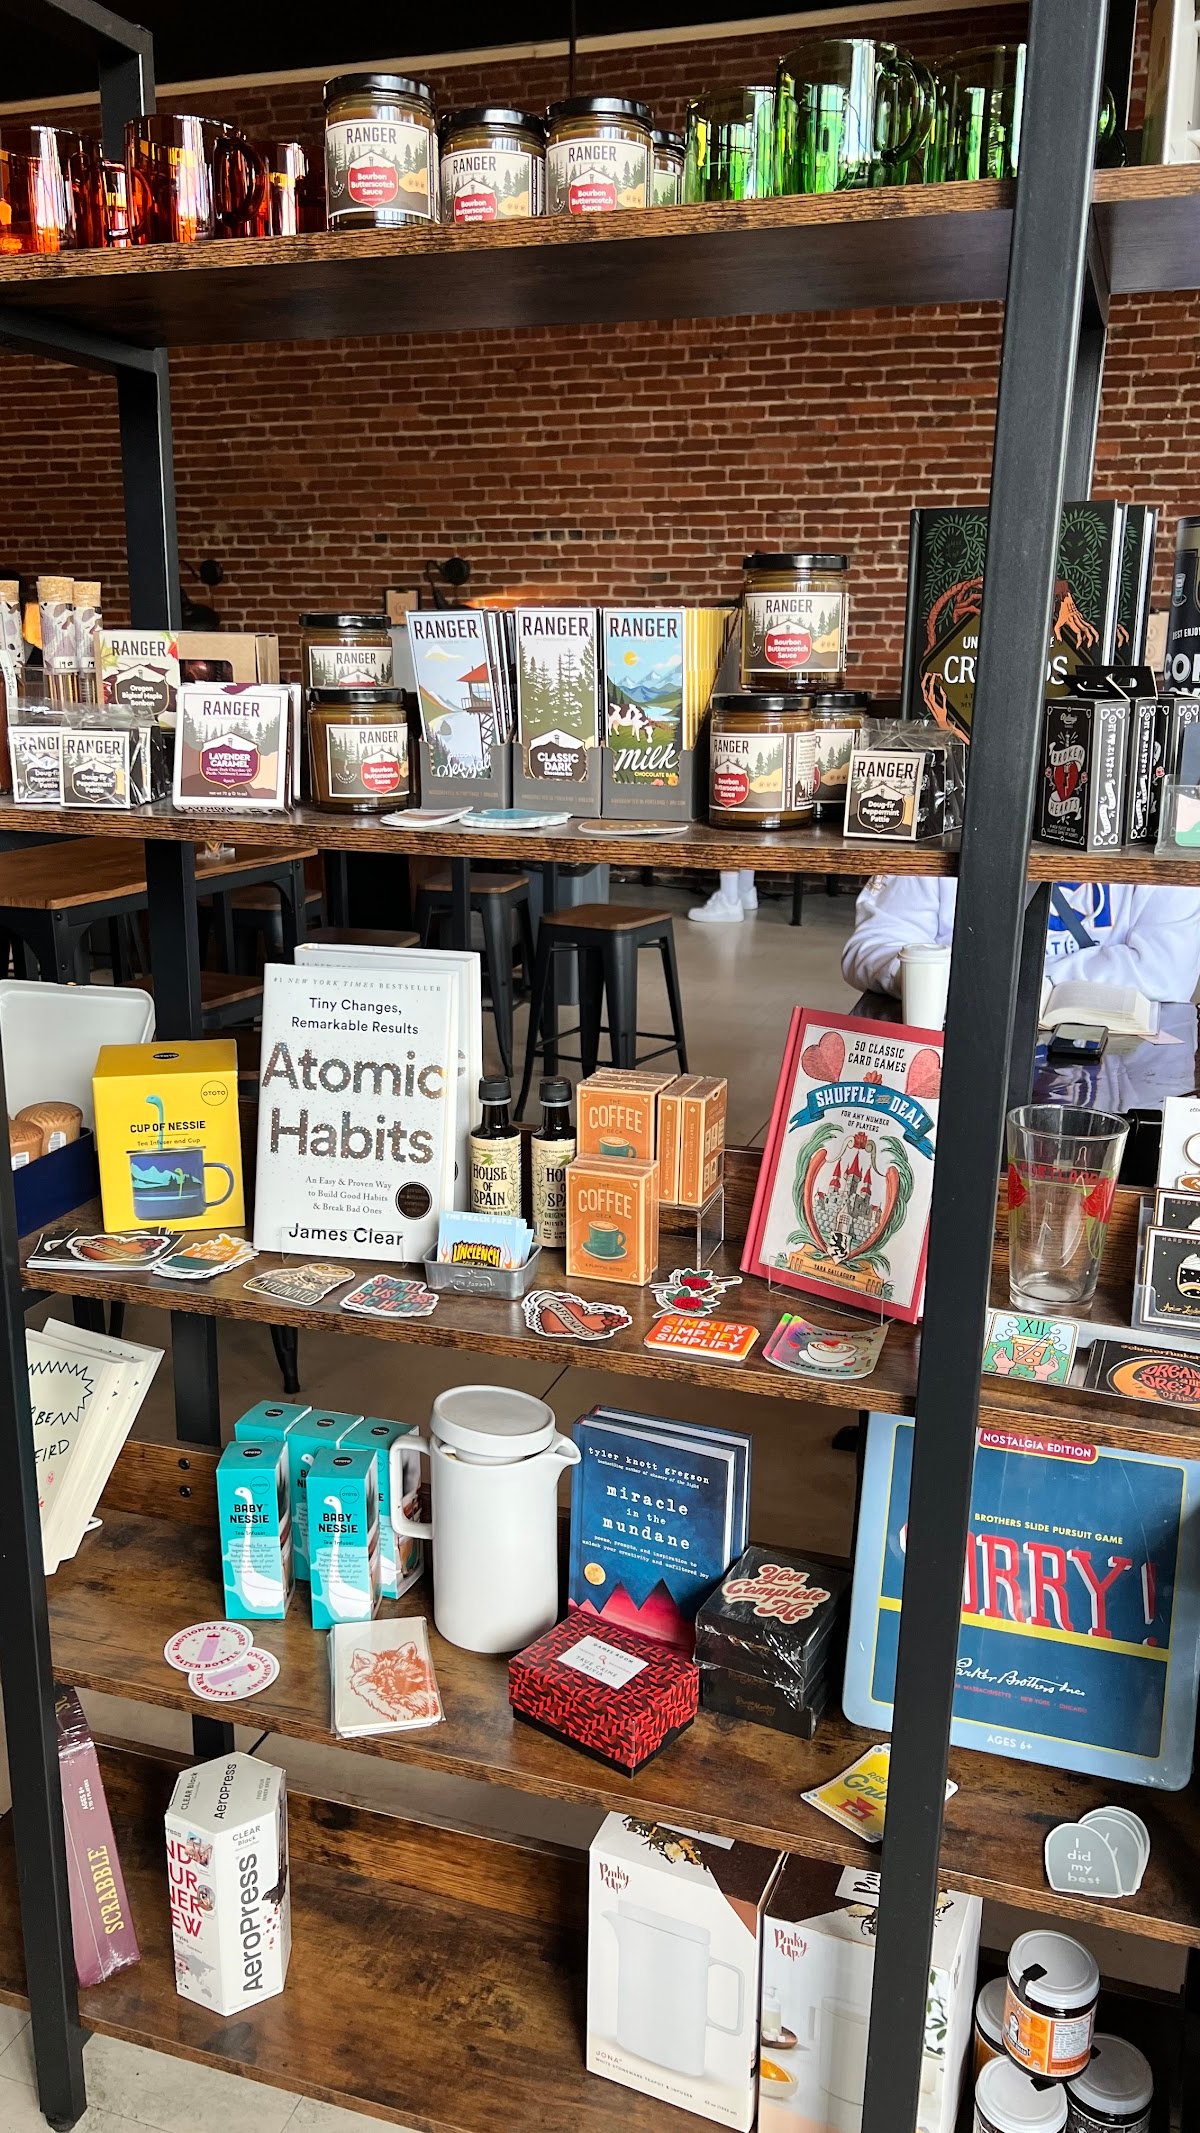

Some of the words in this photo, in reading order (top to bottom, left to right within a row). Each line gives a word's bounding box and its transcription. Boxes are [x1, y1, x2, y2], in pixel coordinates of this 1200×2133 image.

[346, 127, 397, 144] RANGER
[568, 146, 616, 163] RANGER
[453, 156, 496, 174] RANGER
[357, 172, 387, 180] Bourbon
[362, 188, 383, 196] Sauce
[577, 190, 606, 198] Bourbon
[766, 600, 812, 614] RANGER
[413, 618, 478, 640] RANGER
[522, 616, 590, 636] RANGER
[610, 618, 678, 638] RANGER
[112, 640, 167, 656] RANGER
[774, 638, 802, 646] Bourbon
[336, 652, 376, 664] RANGER
[130, 685, 154, 693] Oregon
[203, 700, 260, 717] RANGER
[360, 730, 398, 744] RANGER
[68, 740, 120, 755] RANGER
[714, 739, 748, 754] RANGER
[208, 752, 250, 762] LAVENDER
[210, 760, 249, 768] CARAMEL
[538, 752, 579, 763] CLASSIC
[614, 743, 678, 772] milk
[1053, 746, 1084, 765] BROKEN
[544, 762, 572, 772] DARK
[858, 761, 914, 780] RANGER
[862, 808, 900, 817] Peppermint
[868, 800, 895, 810] Doug-fir
[1050, 800, 1078, 814] HEARTS
[870, 815, 890, 823] Pattie
[344, 980, 374, 988] TIMES
[380, 982, 442, 992] BESTSELLER
[309, 997, 338, 1012] Tiny
[341, 999, 402, 1015] Changes,
[292, 1016, 368, 1032] Remarkable
[372, 1021, 419, 1034] Results
[854, 1040, 866, 1052] 50
[868, 1042, 904, 1058] CLASSIC
[262, 1041, 447, 1100] Atomic
[848, 1052, 872, 1066] CARD
[874, 1057, 906, 1073] GAMES
[816, 1086, 876, 1108] SHUFFLE
[890, 1096, 926, 1130] DEAL
[130, 1124, 150, 1132] CUP
[152, 1122, 166, 1132] OF
[168, 1120, 206, 1130] NESSIE
[589, 1105, 643, 1134] COFFEE
[841, 1110, 852, 1118] FOR
[852, 1112, 864, 1120] ANY
[866, 1116, 890, 1126] NUMBER
[856, 1122, 880, 1132] PLAYERS
[270, 1107, 433, 1165] Habits
[473, 1164, 508, 1181] HOUSE
[305, 1176, 316, 1184] An
[319, 1176, 336, 1186] Easy
[338, 1178, 346, 1186] &
[348, 1179, 374, 1188] Proven
[376, 1180, 392, 1190] Way
[482, 1182, 493, 1192] OF
[318, 1190, 338, 1198] Build
[340, 1191, 360, 1200] Good
[363, 1192, 388, 1202] Habits
[474, 1189, 505, 1206] SPAIN
[578, 1188, 632, 1220] COFFEE
[312, 1202, 320, 1210] &
[322, 1202, 342, 1212] Break
[346, 1204, 360, 1212] Bad
[362, 1205, 382, 1214] Ones
[288, 1222, 348, 1242] James
[354, 1228, 404, 1246] Clear
[1162, 1236, 1182, 1244] HARD
[454, 1241, 501, 1267] UNCLENCH
[249, 1278, 318, 1302] CAFFEINATED
[374, 1276, 423, 1294] SMALL
[350, 1292, 376, 1305] BIG
[377, 1300, 430, 1312] HEART
[360, 1284, 433, 1304] BUSINESS
[549, 1301, 594, 1336] CAFFEINATED
[666, 1317, 750, 1334] SIMPLIFY
[1022, 1318, 1045, 1335] XII
[656, 1332, 740, 1351] SIMPLIFY
[660, 1324, 744, 1342] SIMPLIFY
[984, 1432, 1044, 1450] NOSTALGIA
[1048, 1443, 1092, 1458] EDITION
[588, 1446, 619, 1460] tyler
[626, 1456, 658, 1470] knott
[664, 1467, 710, 1484] gregson
[626, 1466, 641, 1474] author
[686, 1482, 700, 1490] light
[234, 1504, 264, 1513] BABY
[606, 1484, 688, 1516] miracle
[230, 1514, 269, 1524] NESSIE
[322, 1513, 352, 1522] BABY
[626, 1508, 639, 1518] in
[646, 1514, 666, 1525] the
[318, 1524, 358, 1533] NESSIE
[602, 1517, 690, 1550] mundane
[974, 1513, 1022, 1528] BROTHERS
[1024, 1522, 1050, 1532] SLIDE
[1052, 1526, 1092, 1540] PURSUIT
[1094, 1534, 1123, 1545] GAME
[582, 1540, 602, 1548] unlock
[604, 1545, 616, 1554] your
[619, 1549, 650, 1562] creativity
[652, 1558, 662, 1566] and
[666, 1562, 698, 1576] unfiltered
[700, 1572, 710, 1580] joy
[640, 1546, 650, 1555] and
[653, 1551, 688, 1565] inspiration
[754, 1566, 806, 1587] You
[726, 1580, 827, 1603] Complete
[756, 1599, 814, 1622] Me
[172, 1626, 219, 1650] EMOTIONAL
[220, 1626, 246, 1646] SUPPORT
[175, 1654, 200, 1668] WATER
[204, 1651, 240, 1668] BOTTLE
[594, 1642, 614, 1654] GAMES
[615, 1654, 634, 1664] ROOM
[576, 1655, 594, 1666] TRUE
[596, 1664, 618, 1677] CRIME
[581, 1663, 603, 1677] TRIVIA
[956, 1658, 1000, 1684] Parker
[1000, 1670, 1061, 1694] Brothers
[202, 1684, 237, 1696] BOTTLE
[986, 1734, 1016, 1748] AGES
[1019, 1740, 1032, 1750] 6+
[180, 1789, 193, 1810] CLEAR
[187, 1772, 199, 1788] Black
[214, 1764, 237, 1820] AeroPress
[232, 1825, 261, 1842] CLEAR
[238, 1836, 256, 1846] Black
[1076, 1838, 1080, 1848] I
[1067, 1850, 1091, 1862] did
[599, 1862, 630, 1888] Pinky
[1068, 1872, 1100, 1884] best
[1072, 1864, 1092, 1875] my
[87, 1844, 124, 1935] SCRABBLE
[238, 1853, 264, 1992] AeroPress
[774, 1928, 808, 1956] Pinky
